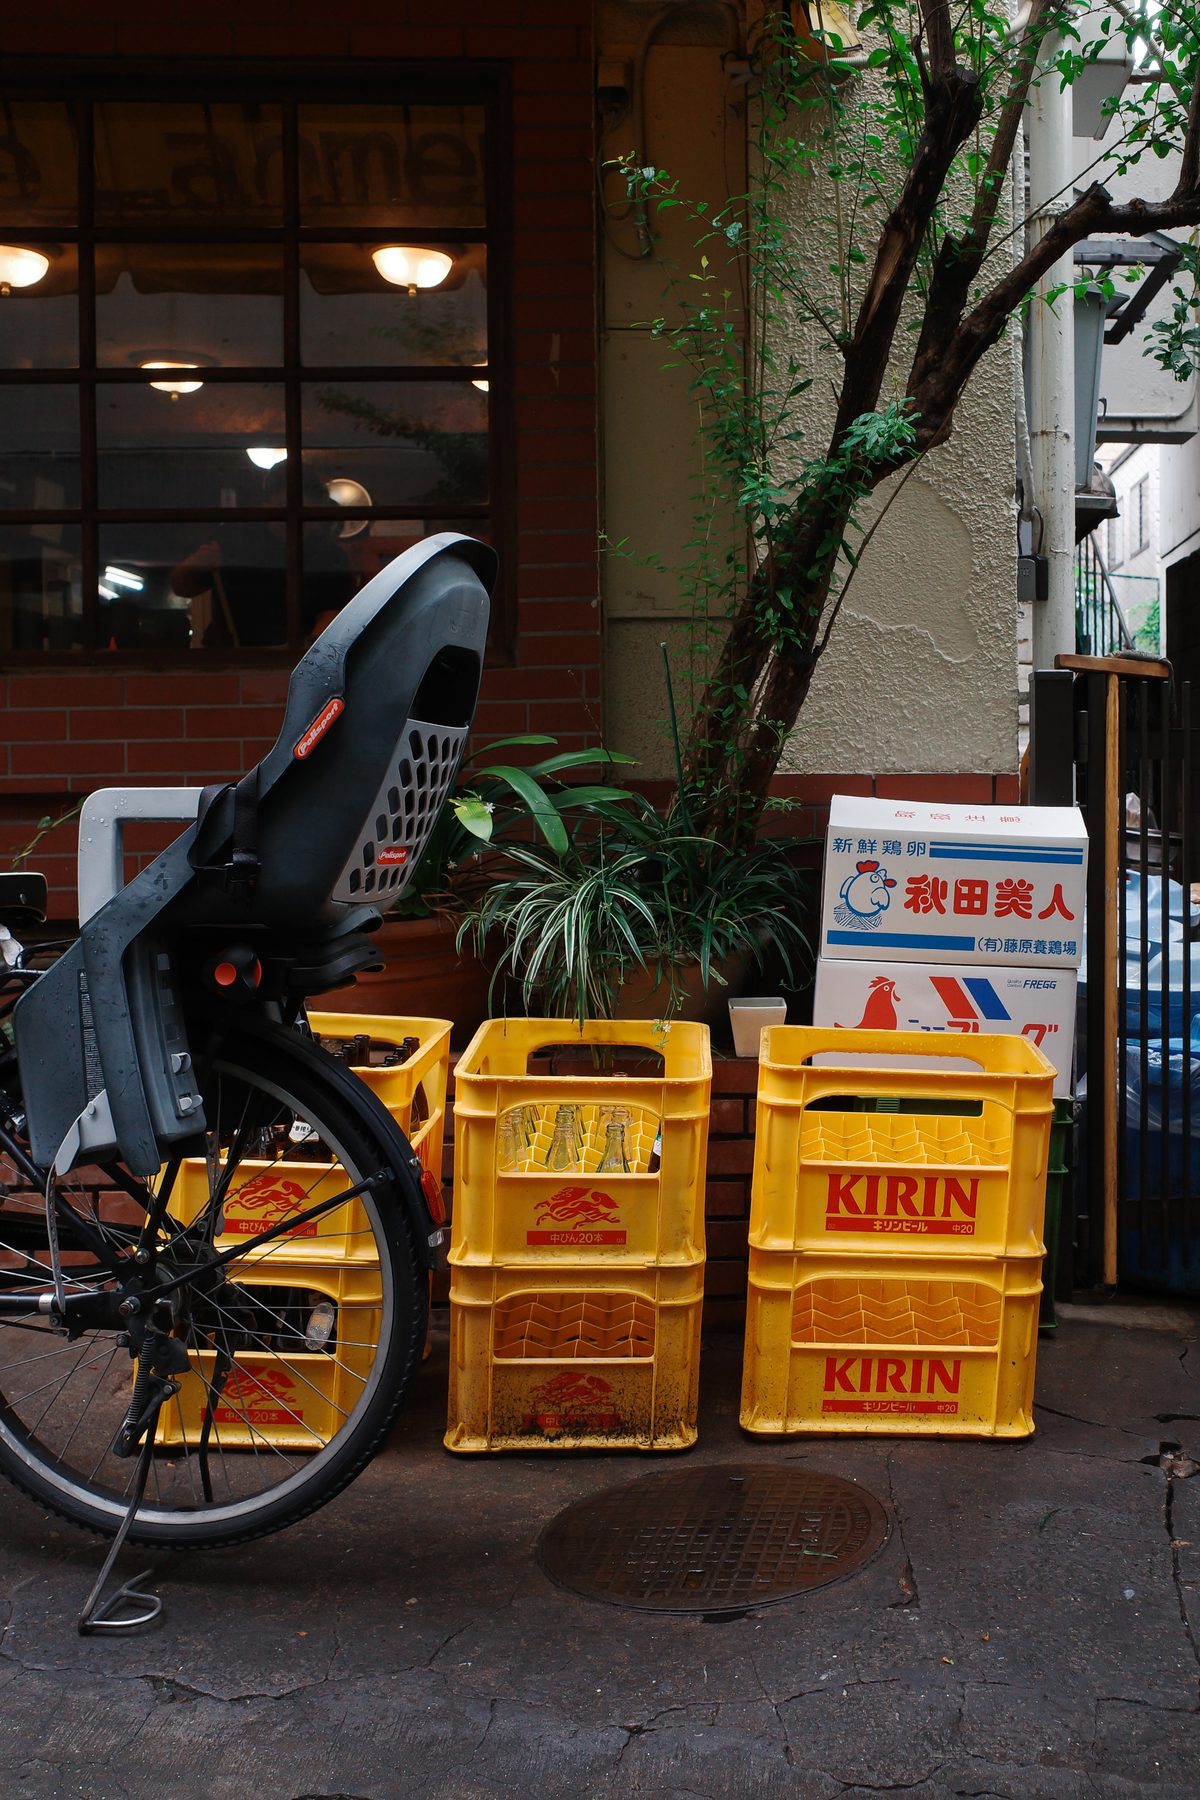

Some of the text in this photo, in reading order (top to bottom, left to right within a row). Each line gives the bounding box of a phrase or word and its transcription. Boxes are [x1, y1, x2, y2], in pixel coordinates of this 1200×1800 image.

[298, 703, 339, 755] Polisport
[378, 850, 407, 860] Polisport
[832, 837, 926, 857] 新鮮鶏卵
[903, 873, 1075, 921] 秋田美人
[1022, 979, 1057, 990] FREGG
[825, 1173, 980, 1219] KIRIN
[873, 1220, 929, 1233] キリンビール
[952, 1224, 973, 1234] 中20
[550, 1232, 604, 1244] 中びん20本
[823, 1357, 962, 1394] KIRIN
[862, 1401, 916, 1412] キリンビール
[937, 1403, 956, 1413] 中20
